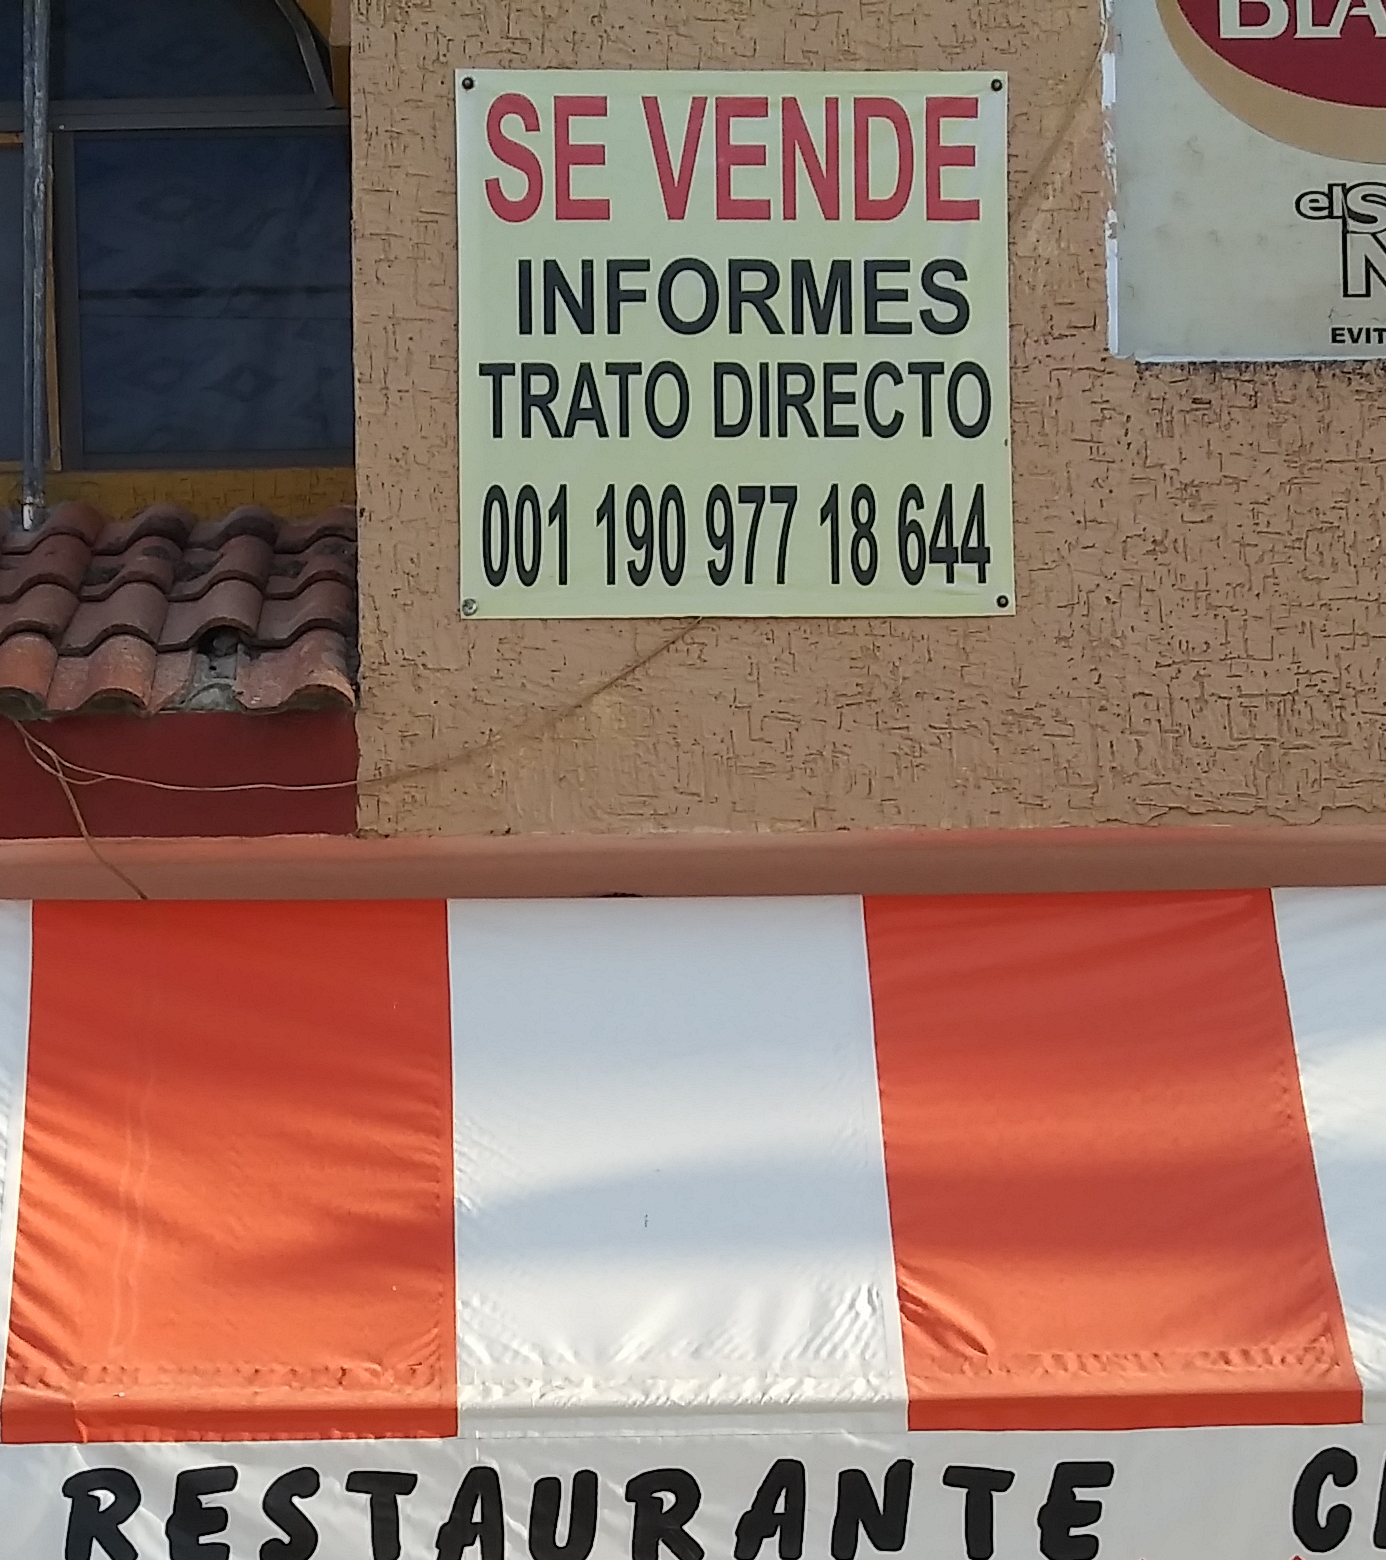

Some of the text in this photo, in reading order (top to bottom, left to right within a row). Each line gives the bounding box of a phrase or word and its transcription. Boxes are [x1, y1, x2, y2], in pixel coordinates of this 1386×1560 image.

[484, 92, 981, 222] SE VENDE
[517, 257, 971, 336] INFORMES
[478, 360, 992, 440] TRATO DIRECTO
[481, 482, 991, 587] 001 190 977 18 644
